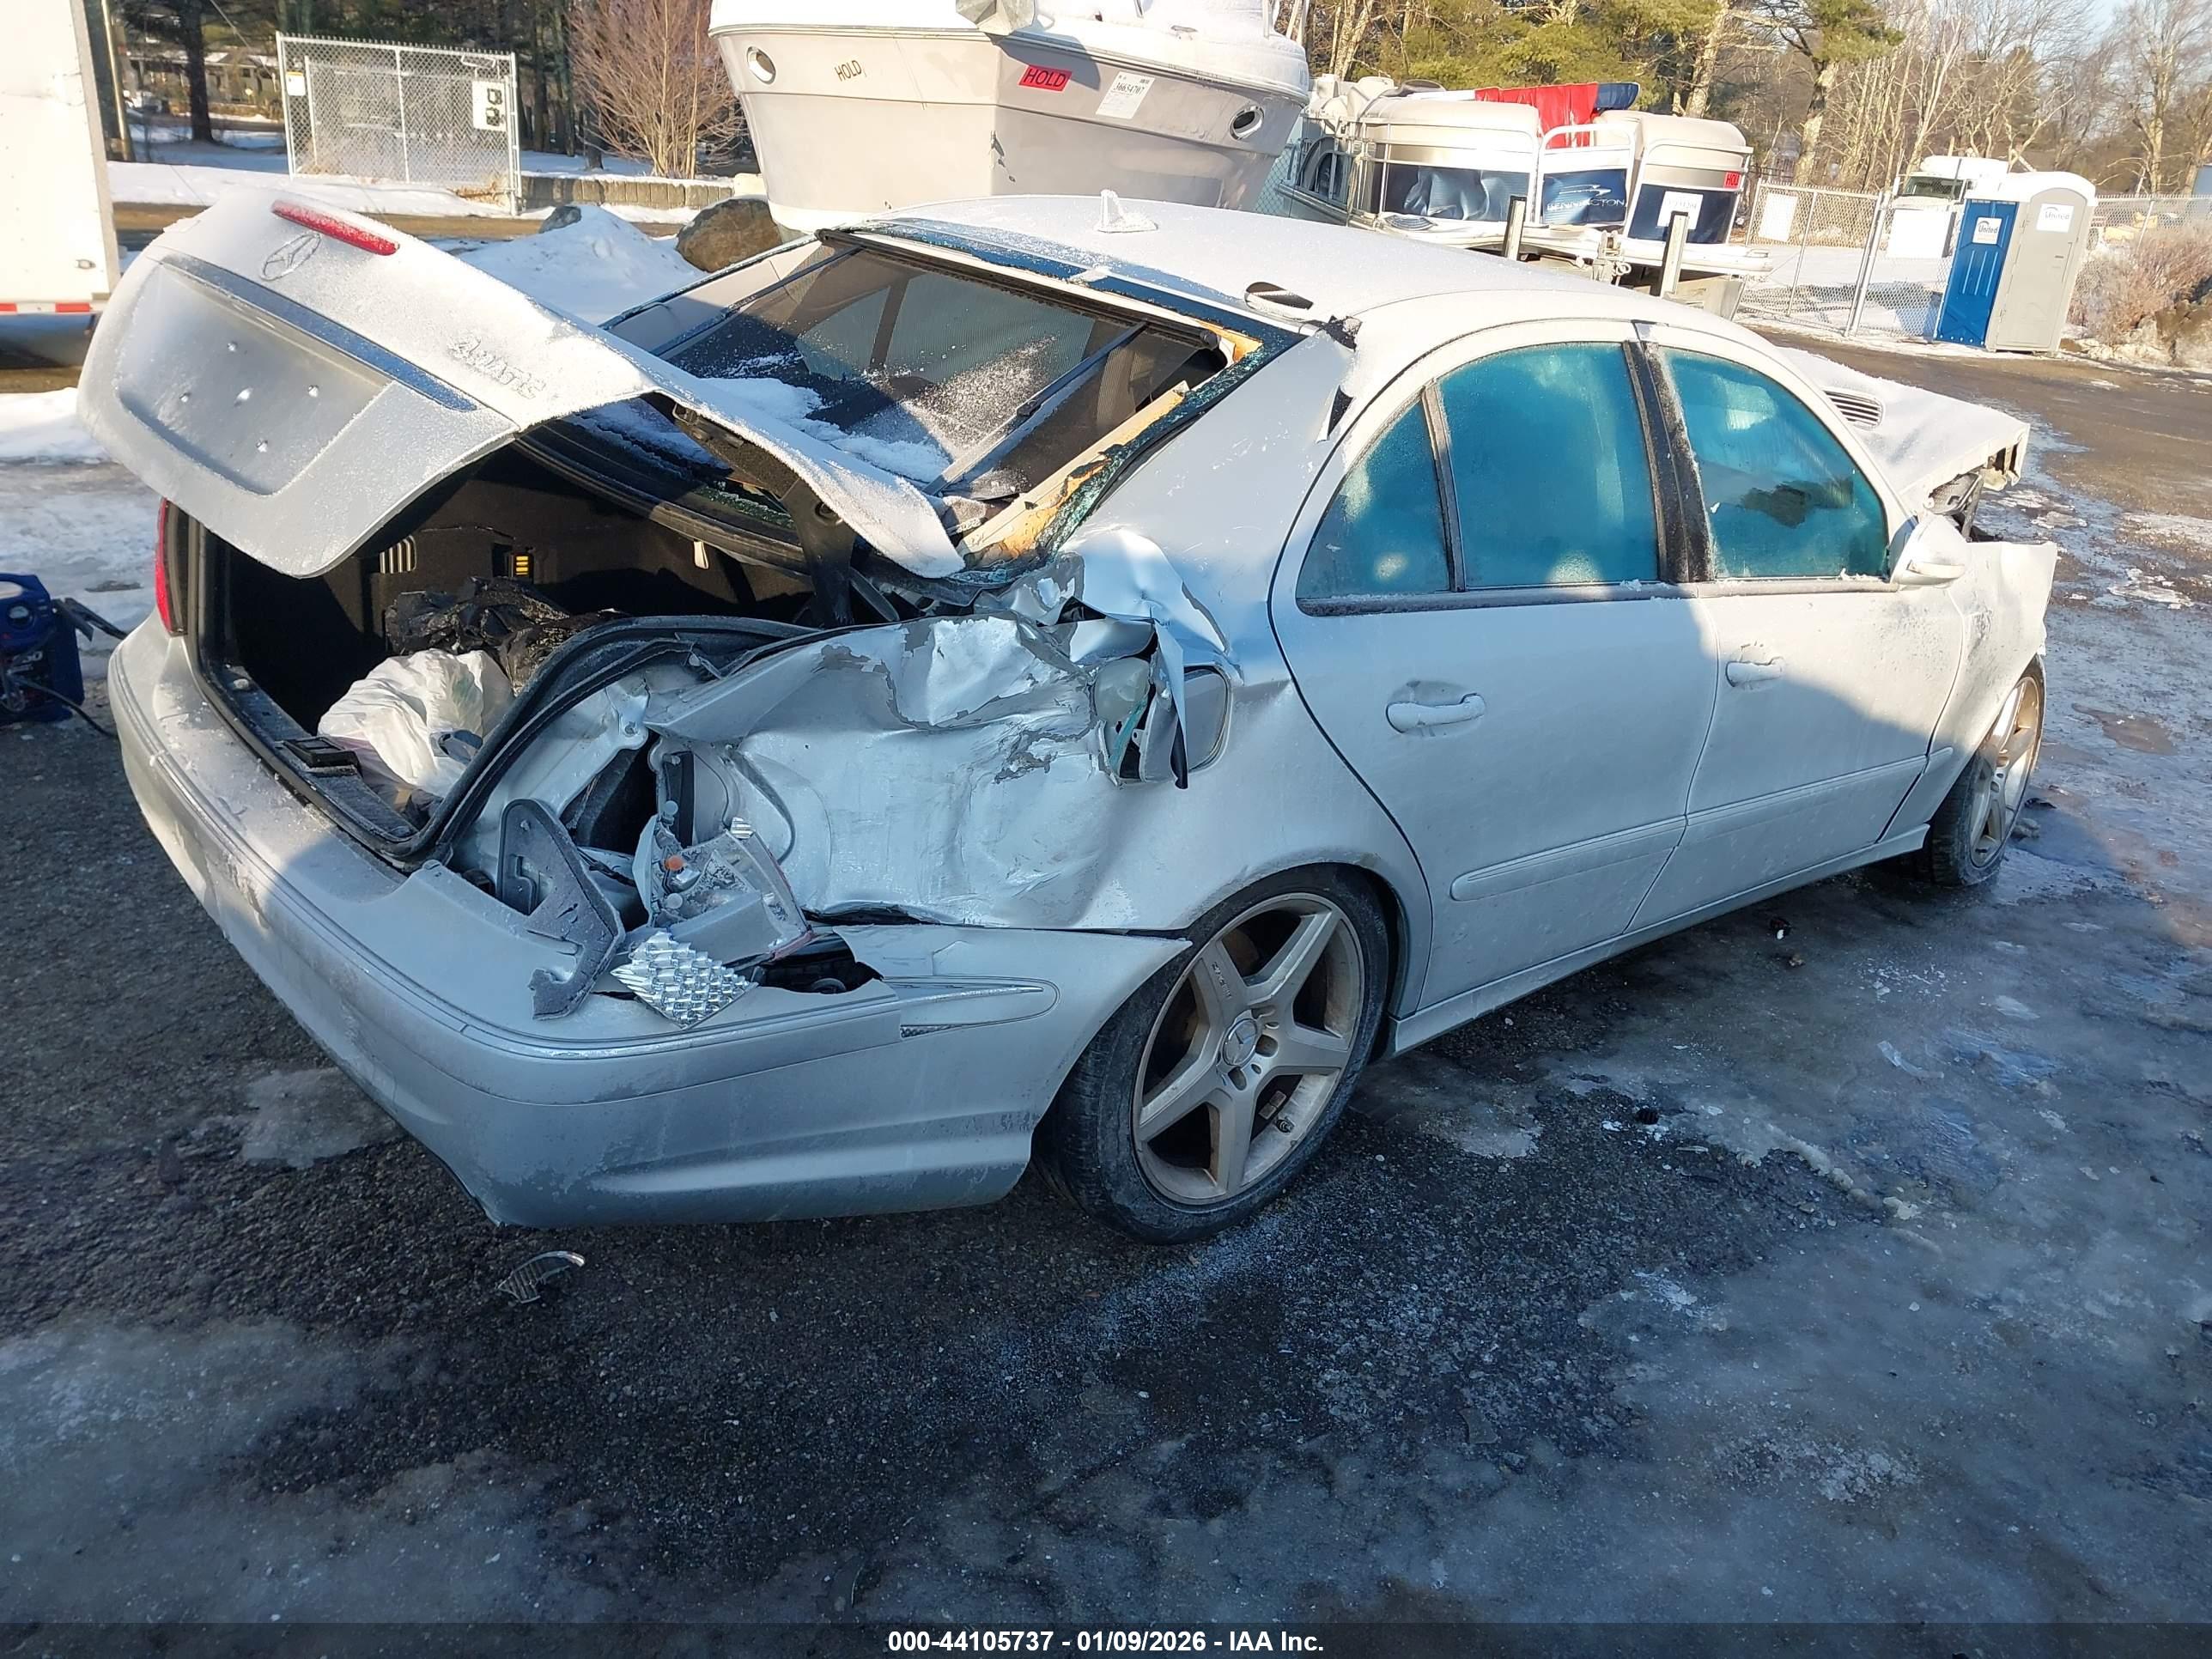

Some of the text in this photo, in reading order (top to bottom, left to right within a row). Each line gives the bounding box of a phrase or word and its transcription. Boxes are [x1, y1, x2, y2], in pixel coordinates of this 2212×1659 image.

[834, 59, 862, 82] HOLD
[1023, 68, 1066, 87] HOLD
[1547, 198, 1625, 211] BENNIGTON
[2045, 210, 2069, 220] United
[1978, 224, 1998, 234] United
